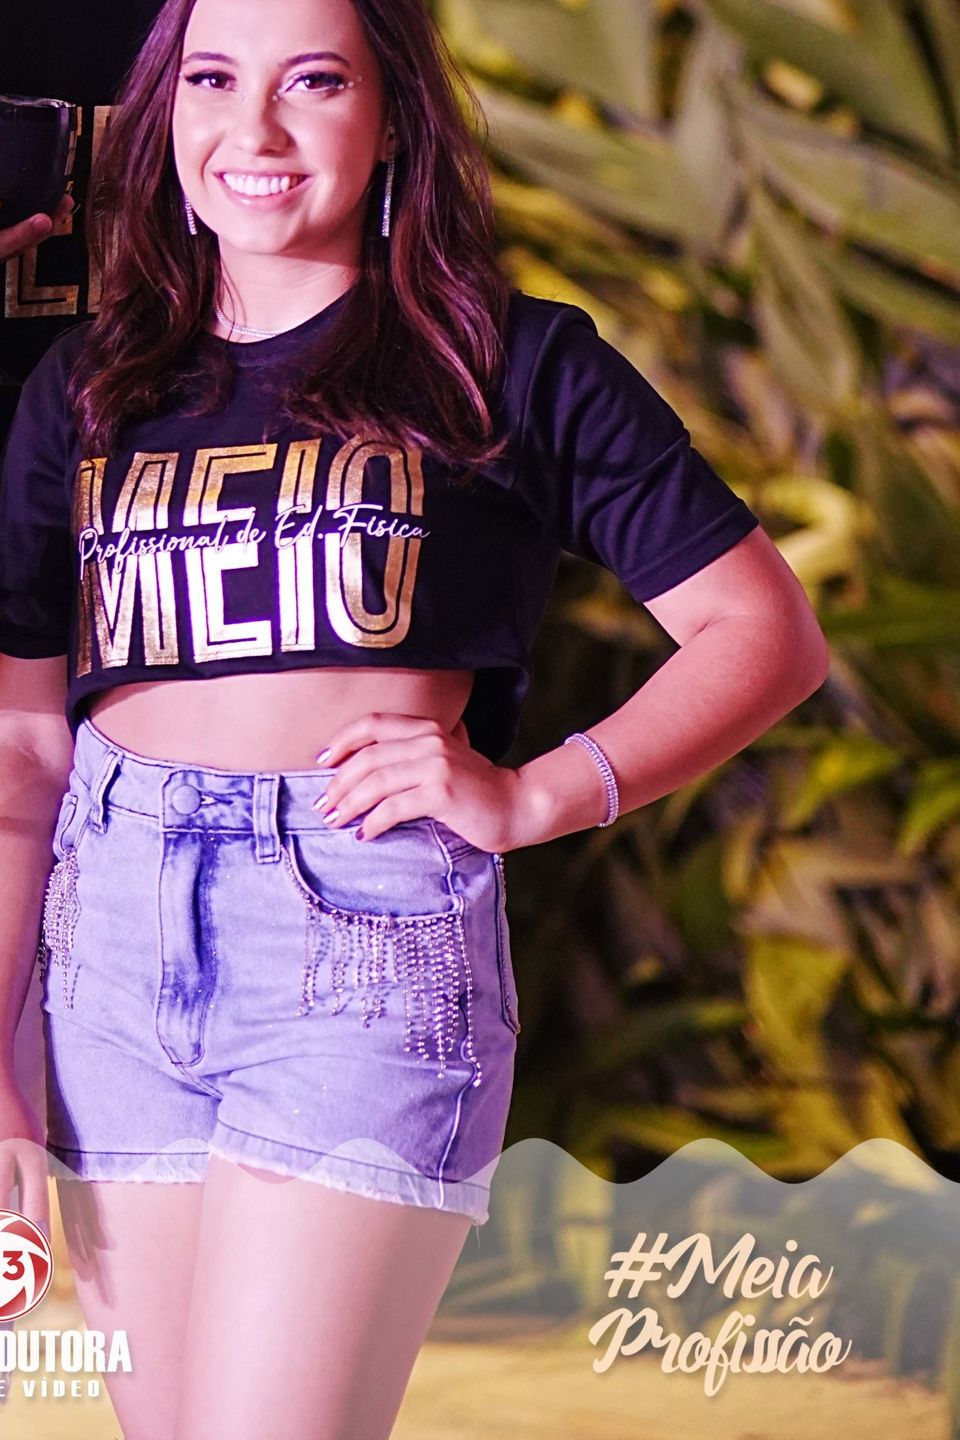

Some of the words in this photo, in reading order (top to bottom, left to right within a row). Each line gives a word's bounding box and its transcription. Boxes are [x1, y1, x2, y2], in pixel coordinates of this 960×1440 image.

[75, 433, 424, 678] MEIO
[78, 514, 230, 582] Profissional
[236, 511, 267, 554] de
[274, 504, 324, 549] Ed.
